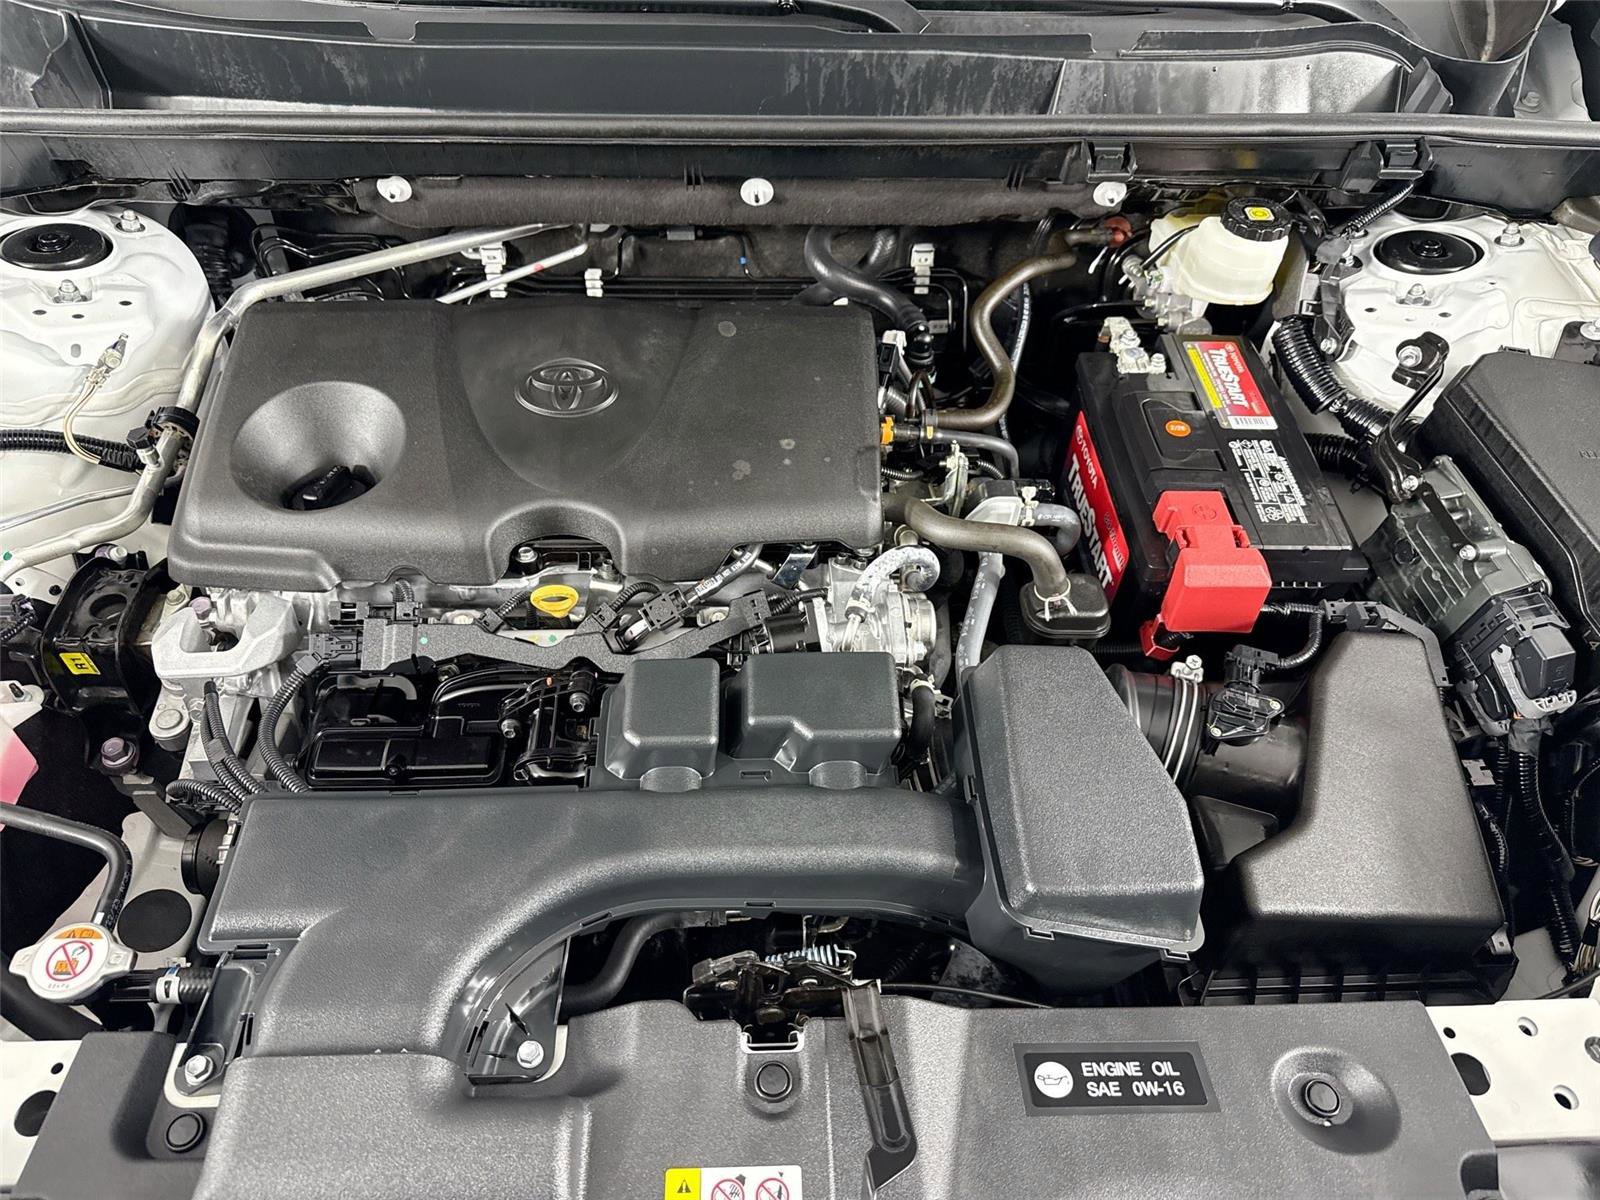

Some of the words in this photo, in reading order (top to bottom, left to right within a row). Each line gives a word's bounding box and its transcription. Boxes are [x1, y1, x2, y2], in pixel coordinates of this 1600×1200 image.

[1080, 443, 1098, 490] TOYOTA
[70, 657, 90, 670] R1
[1080, 1061, 1143, 1077] ENGINE
[1151, 1060, 1180, 1076] OIL
[1086, 1081, 1122, 1097] SAE
[1132, 1080, 1186, 1097] 0W-16
